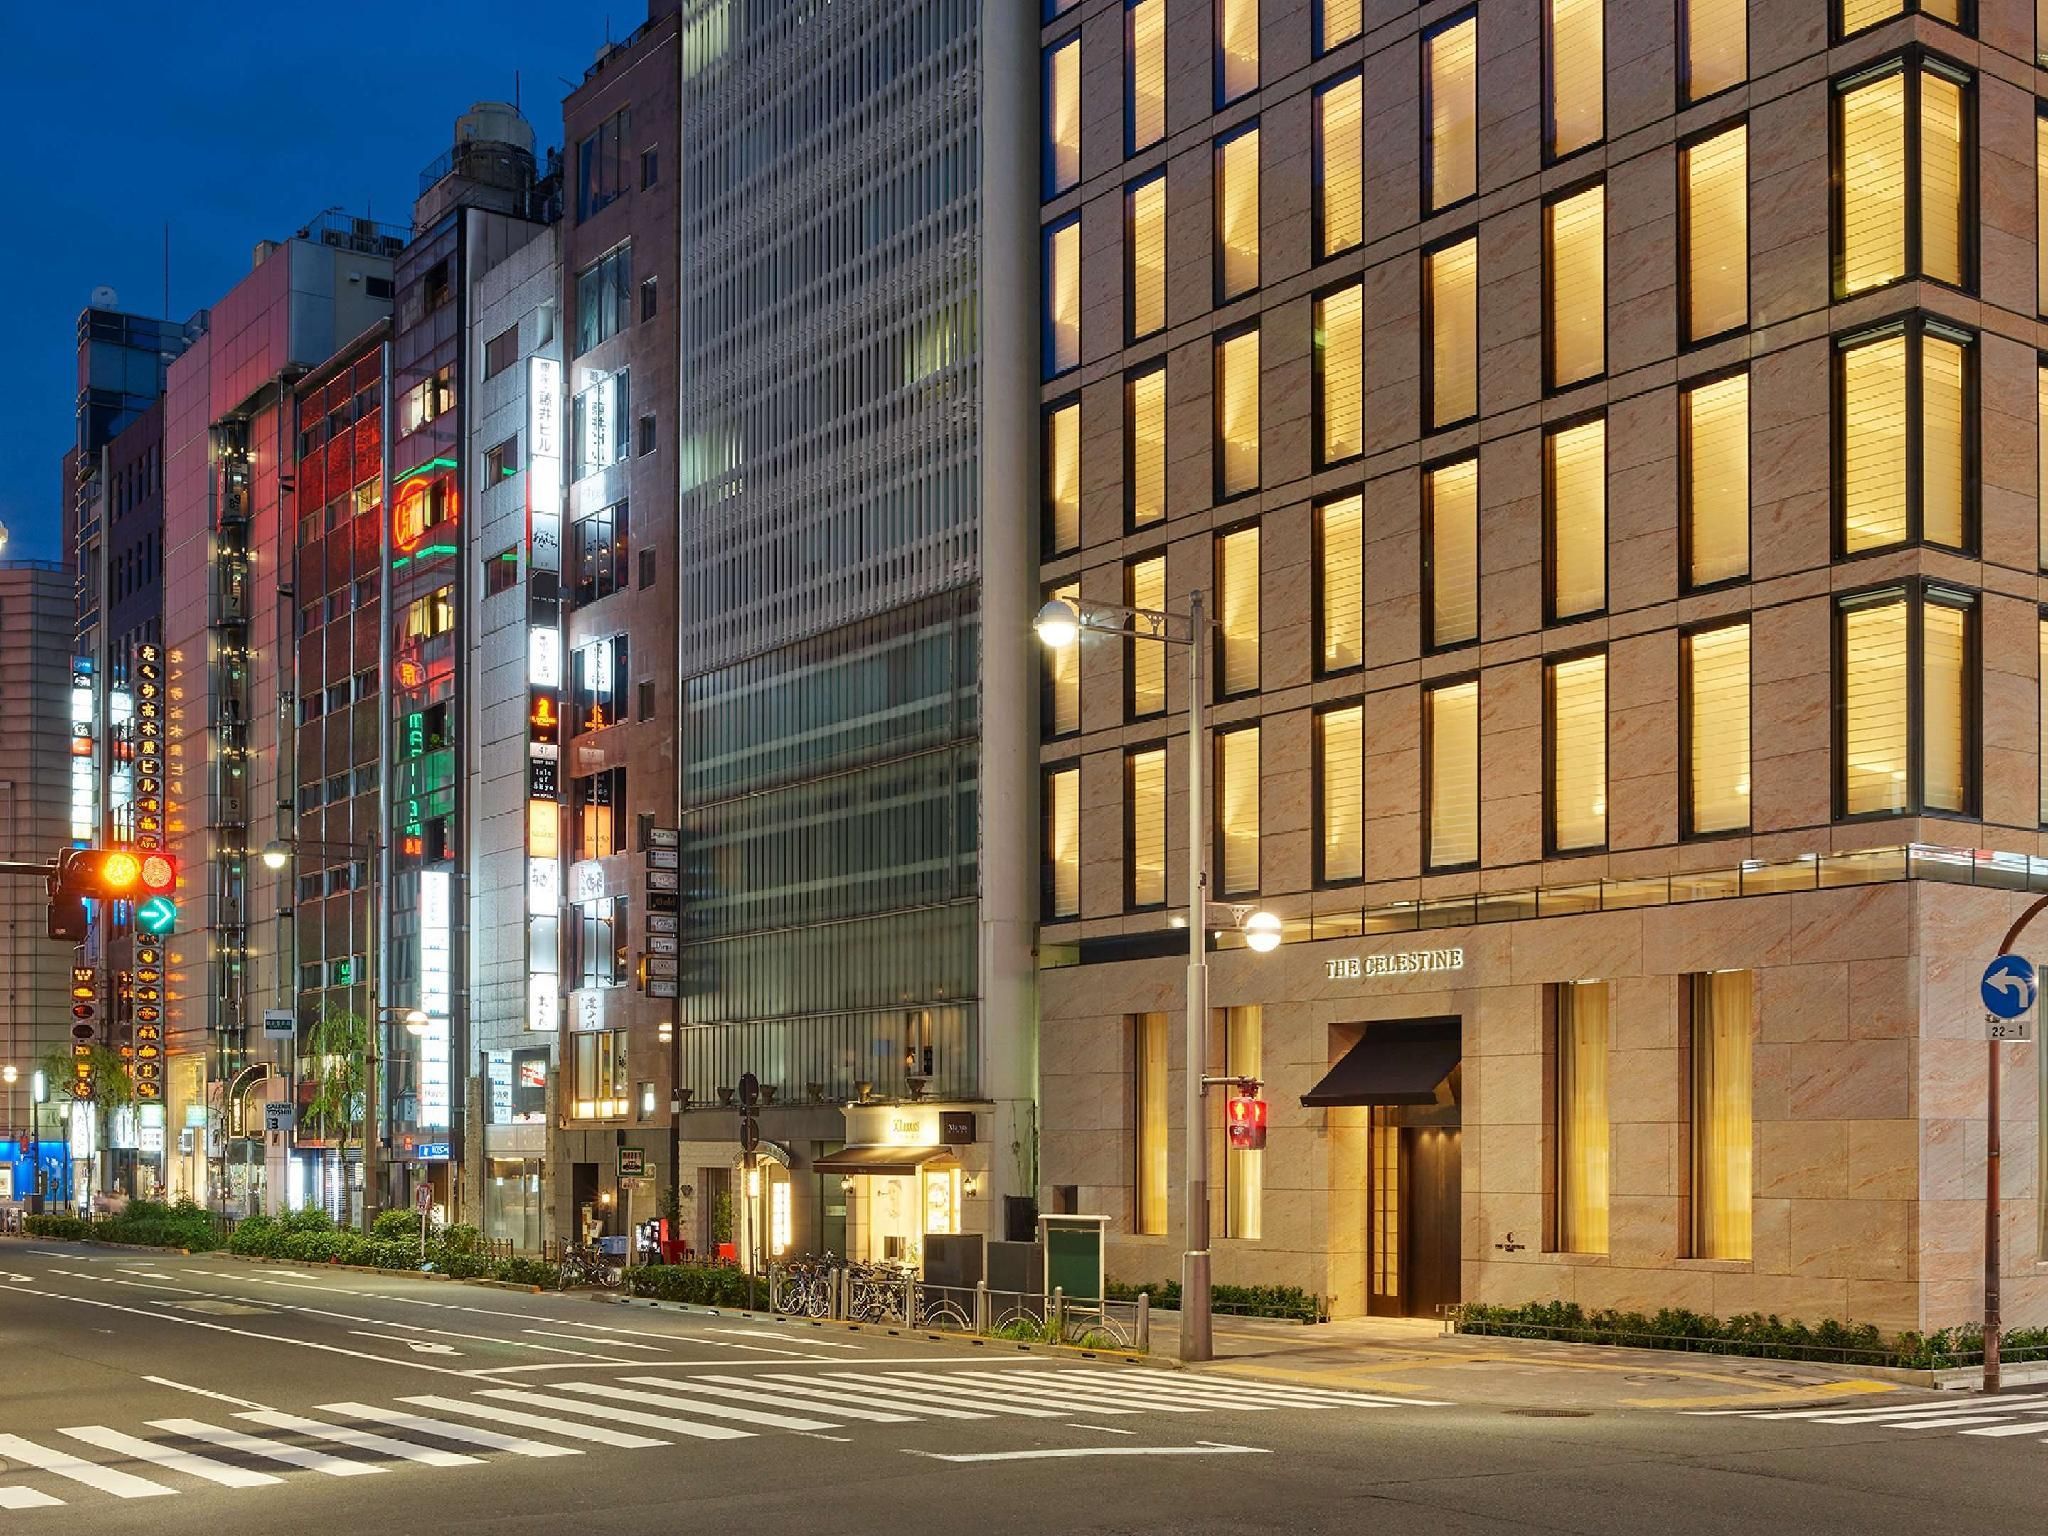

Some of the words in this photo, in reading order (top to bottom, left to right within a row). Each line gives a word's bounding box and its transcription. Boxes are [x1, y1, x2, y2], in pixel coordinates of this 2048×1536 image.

[1324, 959, 1360, 978] THE
[1363, 949, 1463, 976] CELESTINE
[1991, 1024, 2023, 1037] 22-1
